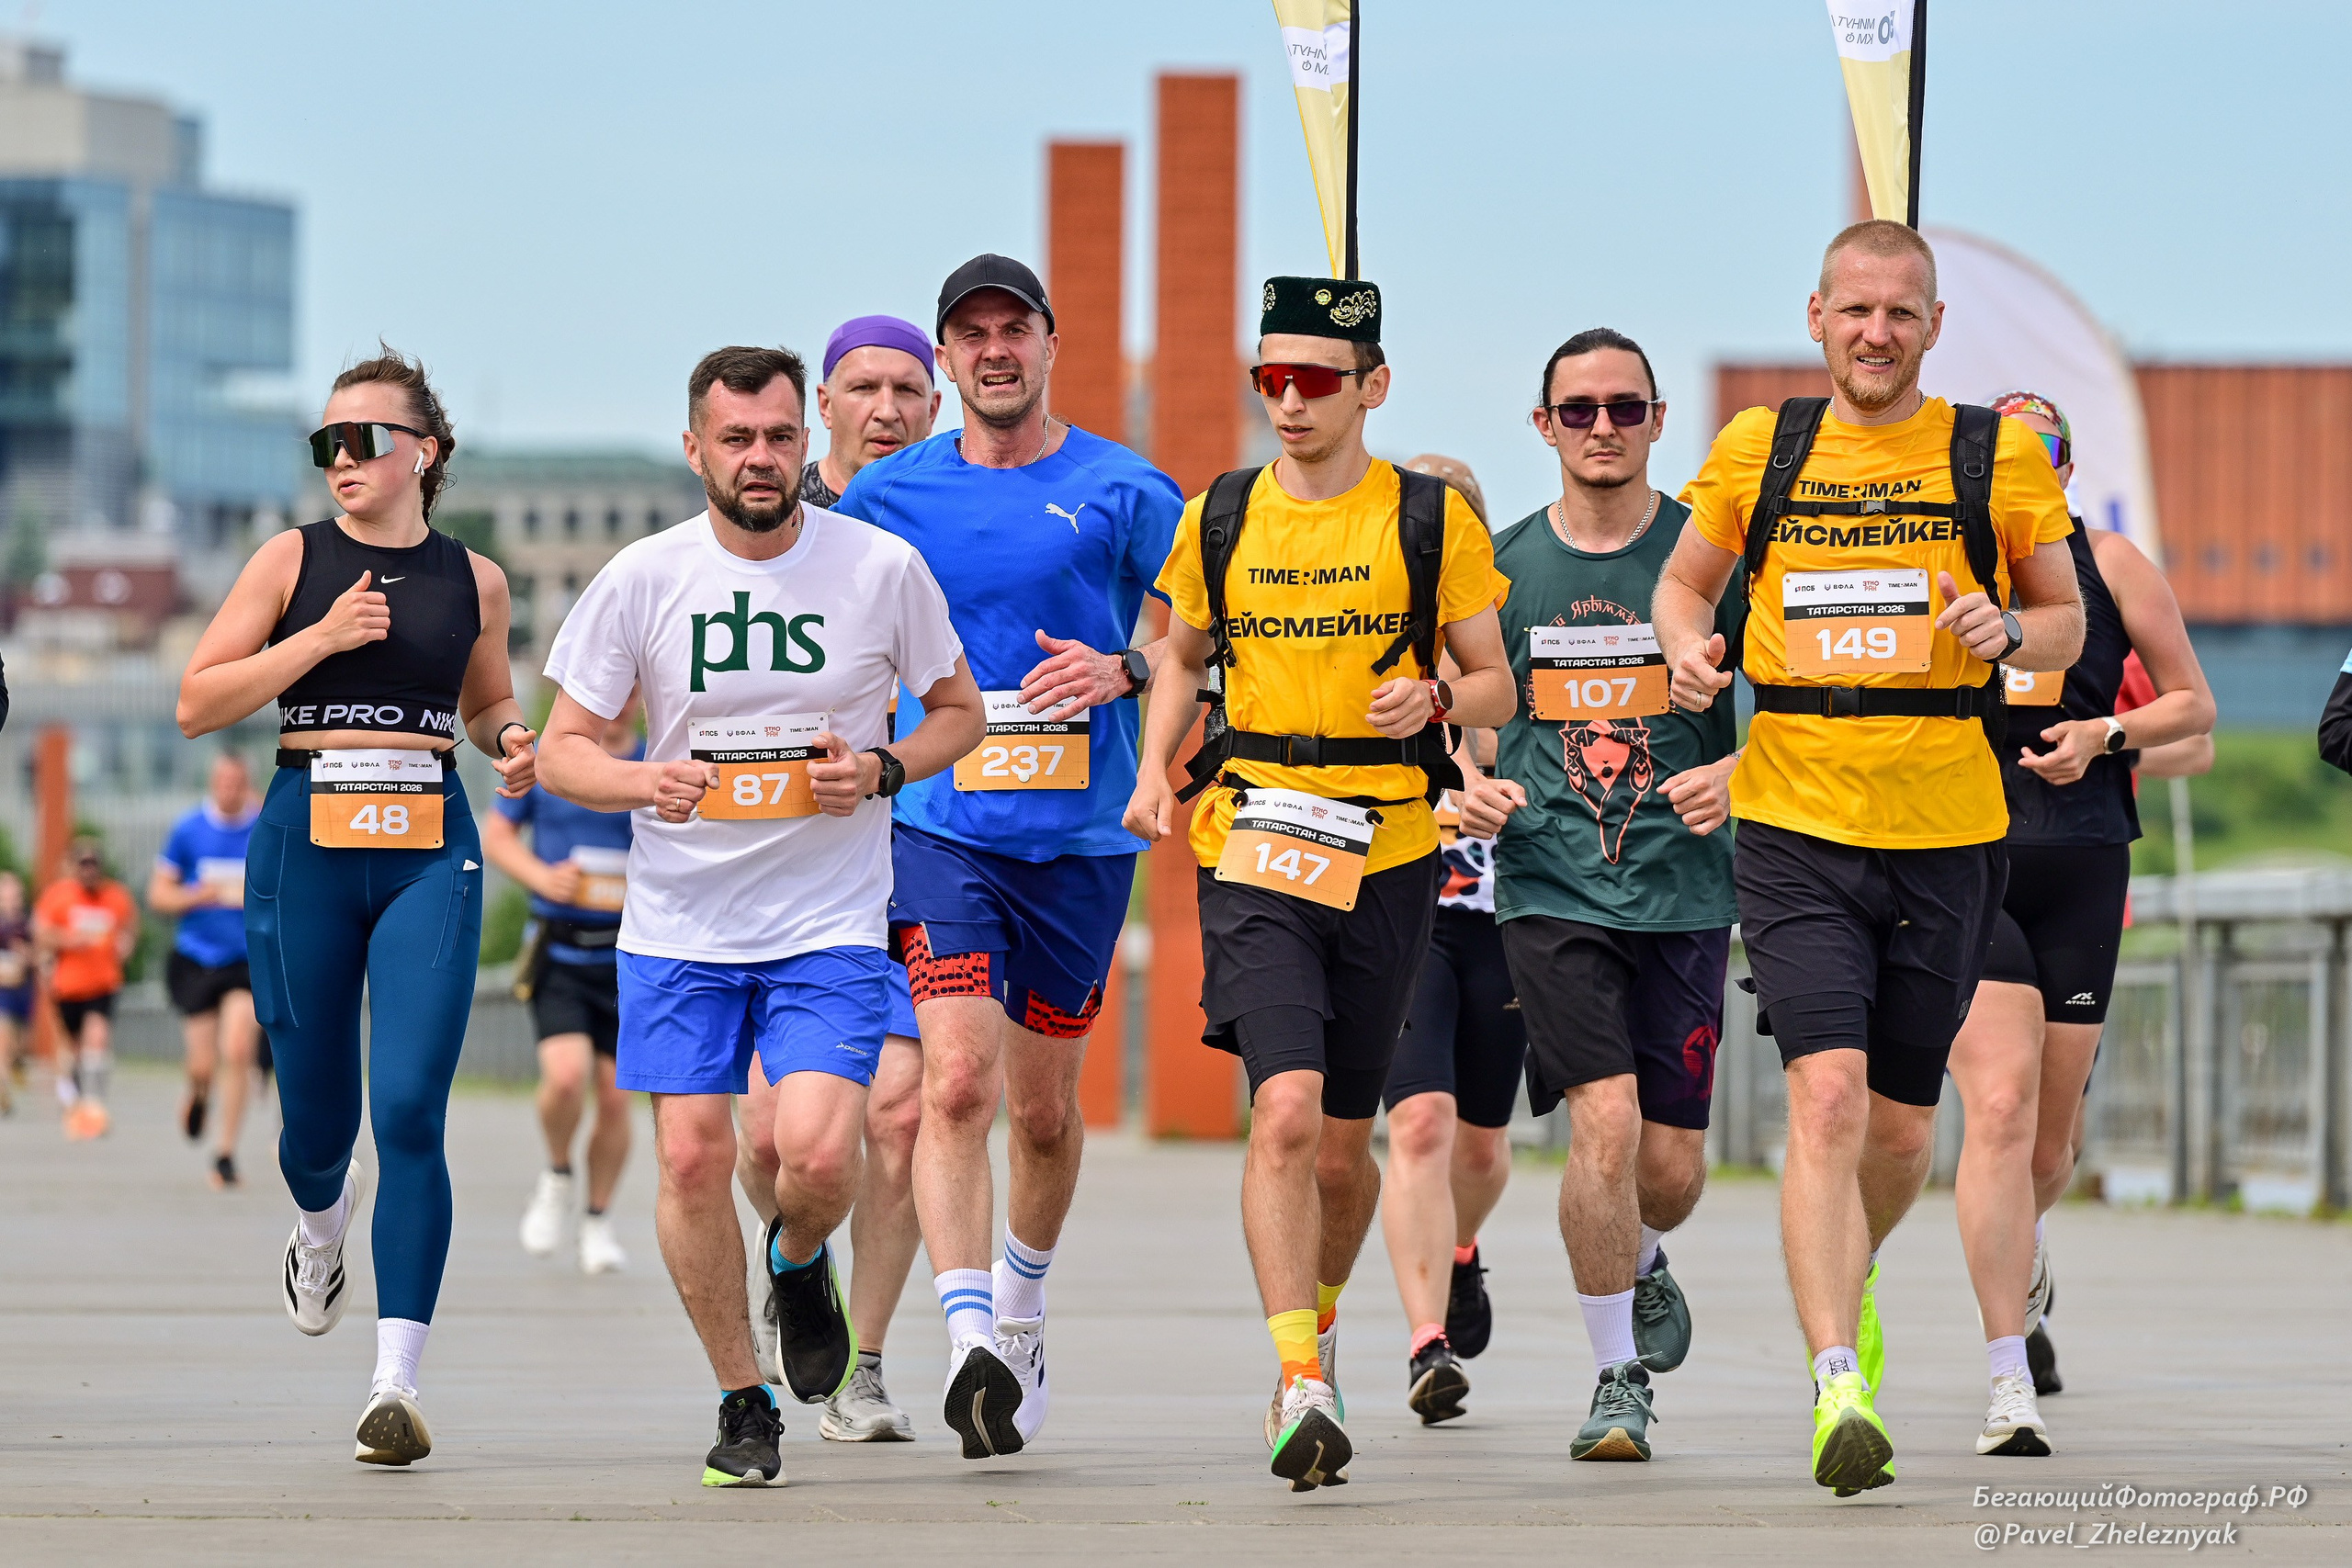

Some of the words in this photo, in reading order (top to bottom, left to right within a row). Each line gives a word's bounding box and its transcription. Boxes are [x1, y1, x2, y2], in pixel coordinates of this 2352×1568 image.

[1768, 517, 1964, 547] ЕЙСМЕЙКЕР
[1227, 608, 1413, 638] ЕЙСМЕЙКЕР
[1571, 594, 1642, 626] Ярымма
[1806, 605, 1874, 616] ТАТАРСТАН
[1877, 604, 1905, 614] 2026
[690, 591, 825, 692] phs
[1815, 626, 1897, 660] 149
[1553, 659, 1616, 667] ТАТАРСТАН
[1618, 657, 1645, 666] 2026
[1564, 677, 1637, 708] 107
[280, 705, 317, 727] IKE
[322, 705, 404, 725] PRO
[987, 724, 1040, 733] ТАРСТАН
[1042, 724, 1069, 732] 2026
[711, 750, 776, 761] ТАТАРСТАН
[779, 749, 808, 759] 2026
[981, 745, 1065, 776] 237
[334, 783, 398, 792] ТАТАРСТАН
[400, 784, 423, 792] 2026
[732, 773, 790, 806] 87
[349, 804, 410, 835] 48
[1283, 802, 1303, 811] ВФЛА
[1251, 820, 1317, 840] ТАТАРСТАН
[1318, 833, 1346, 848] 2026
[1255, 842, 1330, 886] 147
